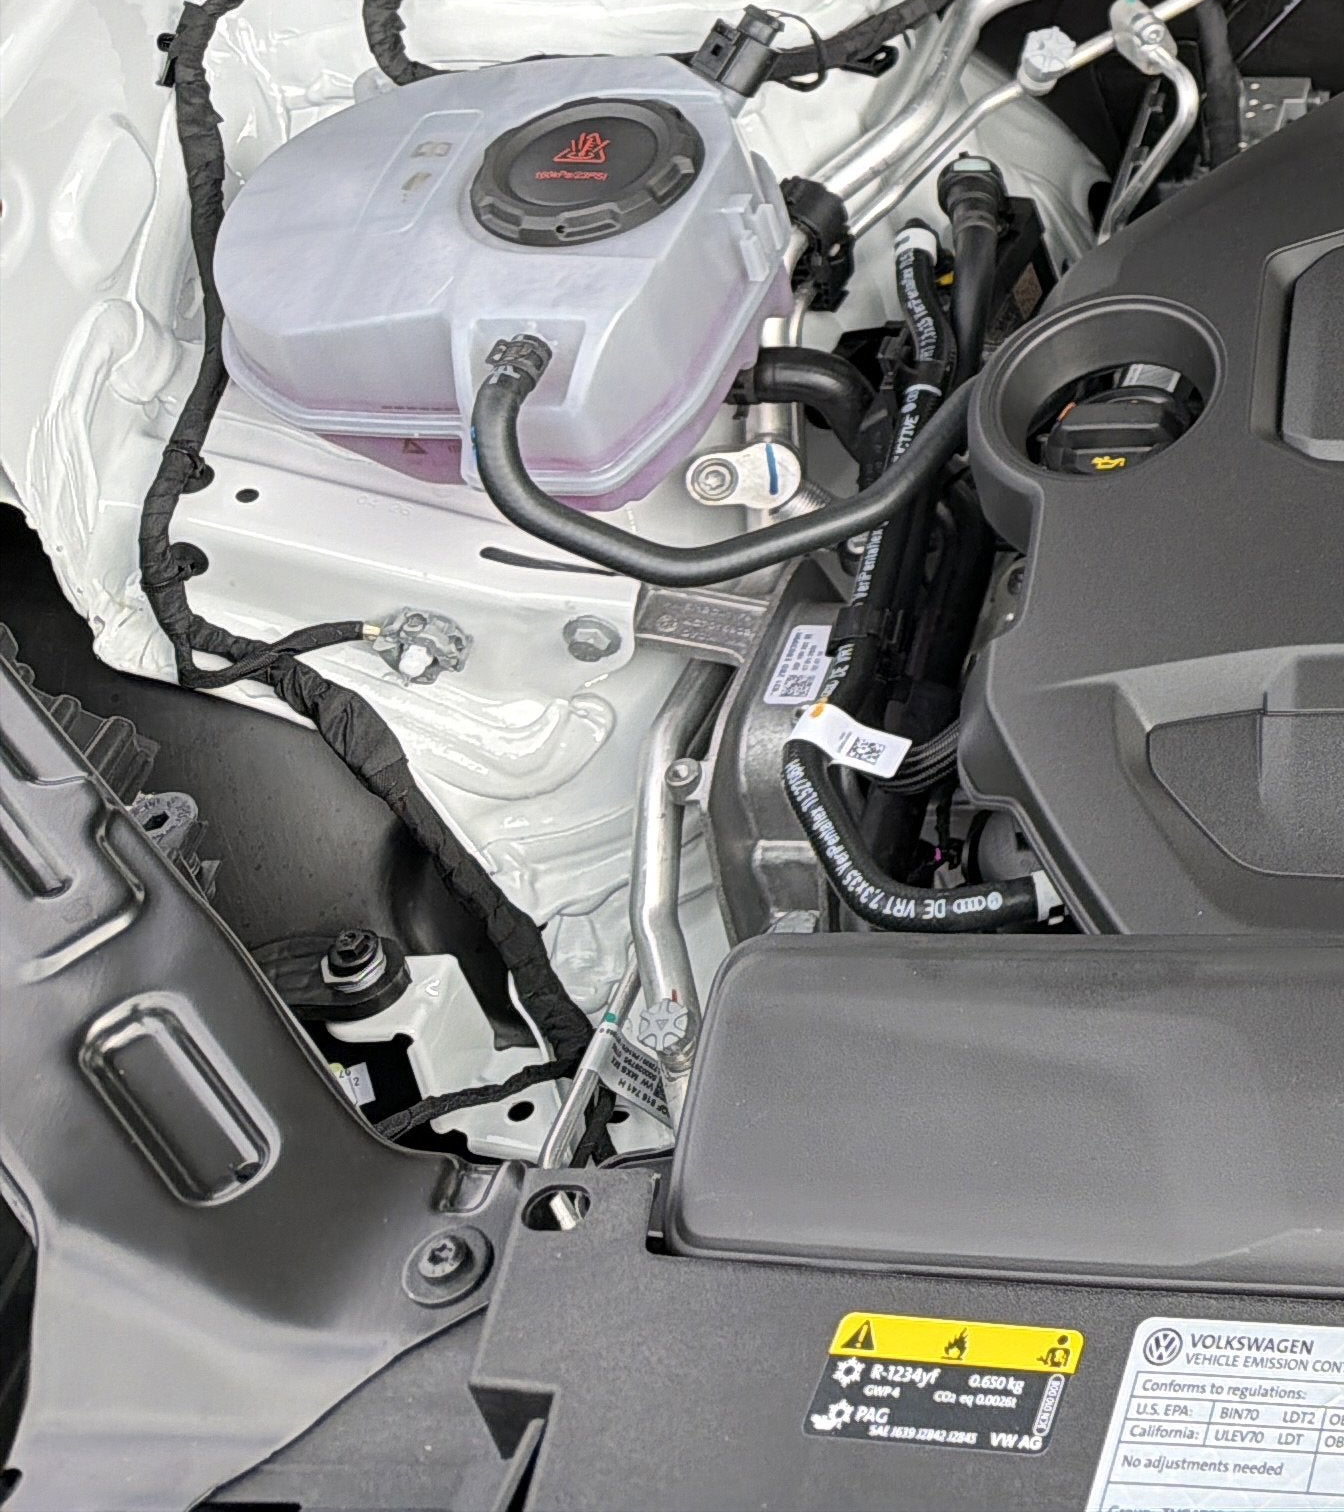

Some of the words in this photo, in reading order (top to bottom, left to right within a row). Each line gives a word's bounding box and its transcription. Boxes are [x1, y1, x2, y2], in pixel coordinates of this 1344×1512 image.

[882, 895, 915, 919] VRT
[922, 899, 946, 919] DE
[1190, 1333, 1315, 1355] VOLKSWAGEN
[1186, 1353, 1239, 1367] VEHICLE
[1243, 1355, 1310, 1372] EMISSION
[869, 1363, 942, 1388] R-1234yf
[967, 1374, 1006, 1389] 0.650
[1006, 1376, 1025, 1395] kg
[1142, 1378, 1206, 1394] Conforms
[1210, 1380, 1223, 1395] to
[1226, 1383, 1307, 1400] regulations:
[958, 1393, 973, 1408] eq
[1135, 1402, 1159, 1416] U.S.
[1163, 1403, 1193, 1417] EPA:
[854, 1405, 891, 1424] PAG
[1219, 1407, 1260, 1421] BIN70
[1282, 1411, 1316, 1425] LDT2
[989, 1432, 1019, 1448] VW
[1019, 1435, 1043, 1451] AG
[1129, 1424, 1200, 1440] California:
[1214, 1429, 1265, 1444] ULEV70
[1277, 1433, 1304, 1446] LDT
[1121, 1454, 1141, 1468] No
[1144, 1456, 1230, 1474] adjustments
[1232, 1461, 1284, 1476] needed
